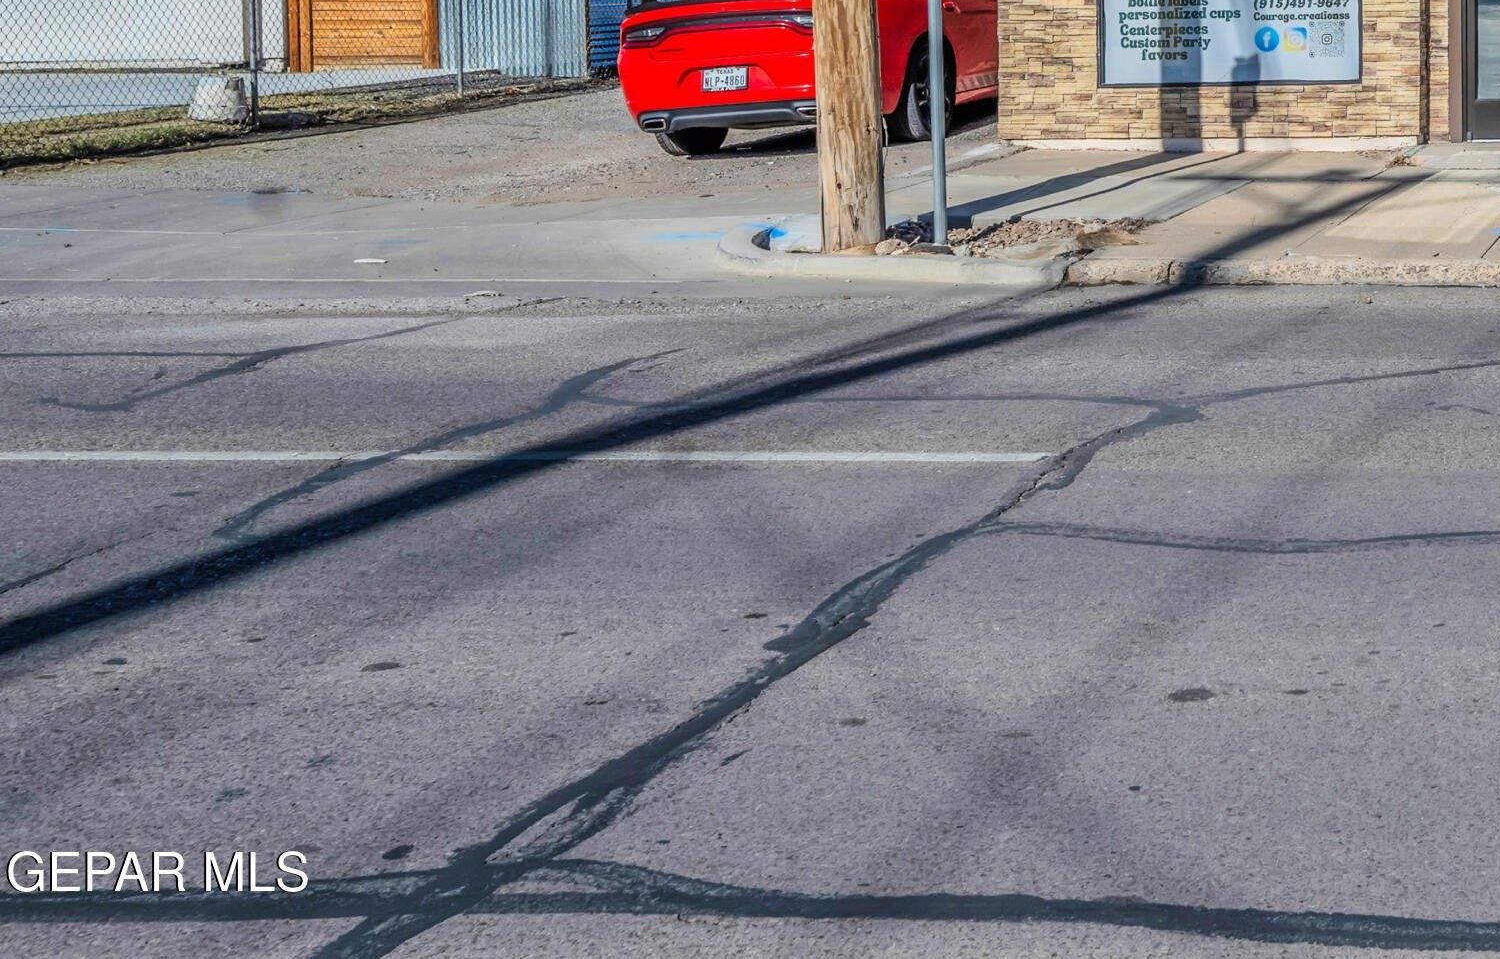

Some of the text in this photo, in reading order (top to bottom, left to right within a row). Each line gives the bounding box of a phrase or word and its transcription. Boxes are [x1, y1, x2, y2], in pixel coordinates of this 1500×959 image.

[1118, 7, 1241, 24] personalized cups
[1253, 10, 1350, 23] Courage.creationss
[1119, 23, 1208, 38] Centerpieces
[1120, 37, 1211, 50] Custom Party
[1141, 49, 1188, 61] favors
